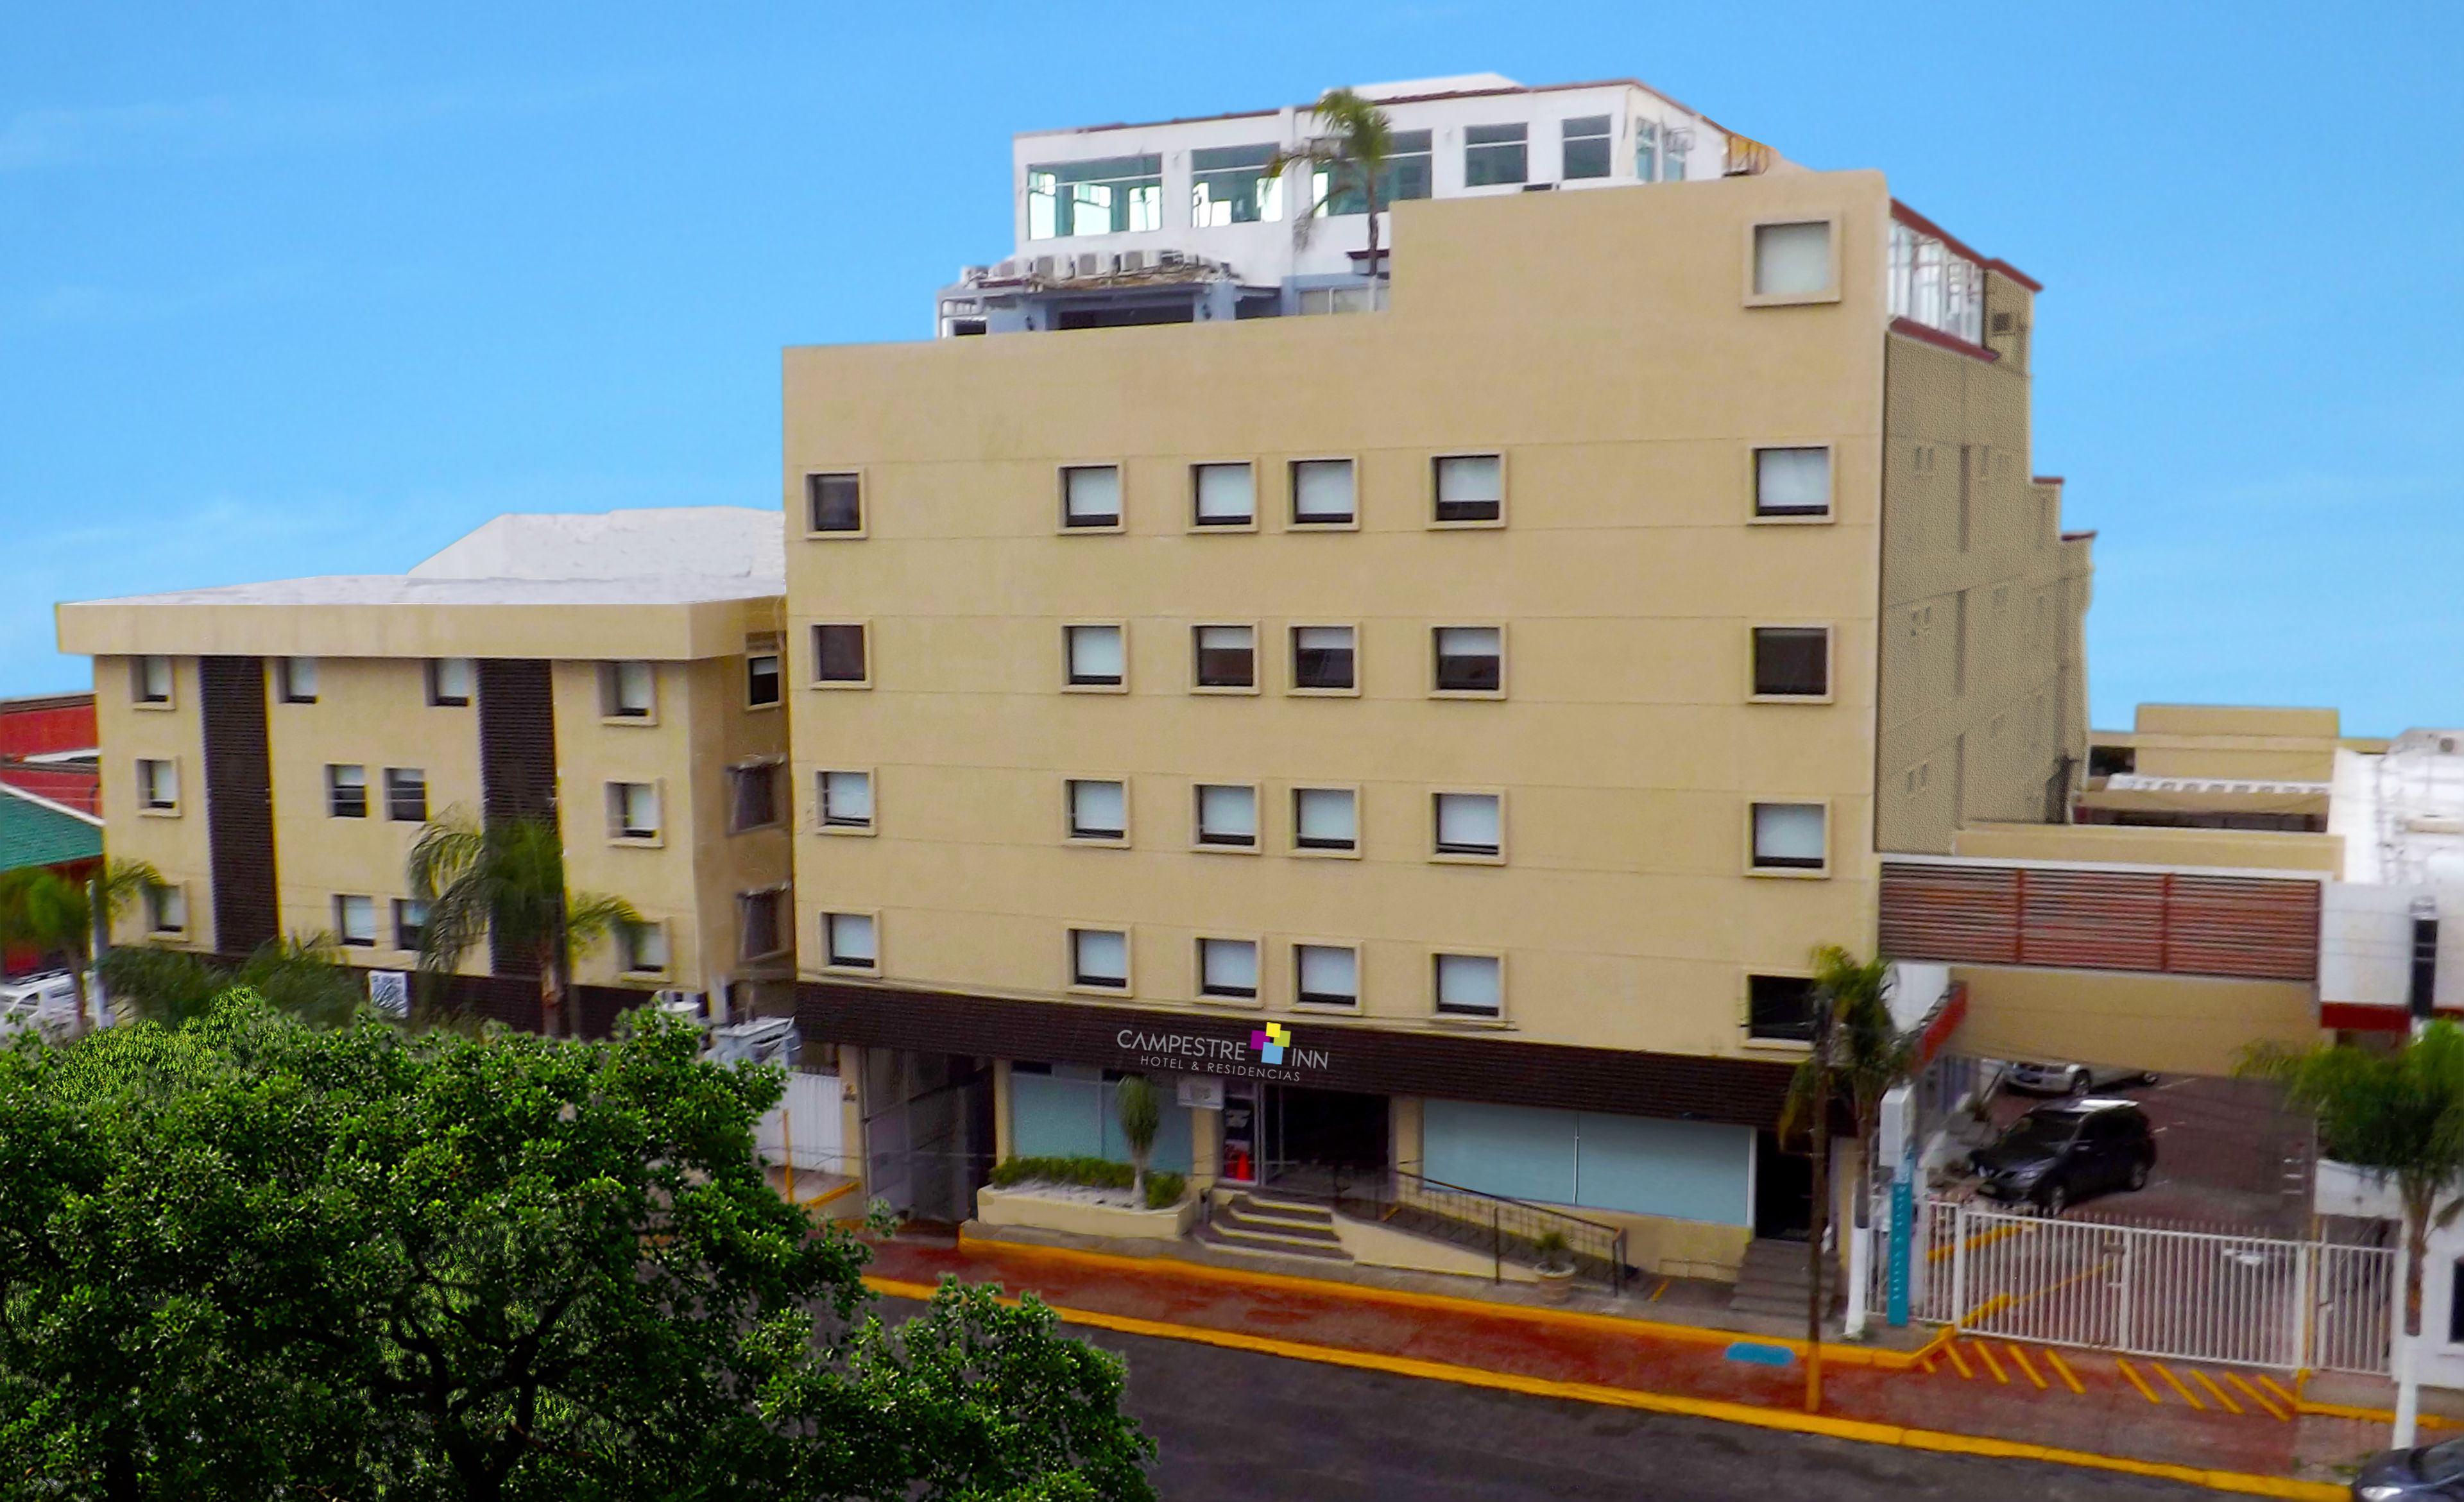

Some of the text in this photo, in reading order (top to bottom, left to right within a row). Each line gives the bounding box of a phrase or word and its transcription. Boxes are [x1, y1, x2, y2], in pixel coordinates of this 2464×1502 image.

[1117, 1029, 1328, 1070] CAMPESTRE INN
[1140, 1055, 1300, 1082] HOTEL & RESIDENCIAS
